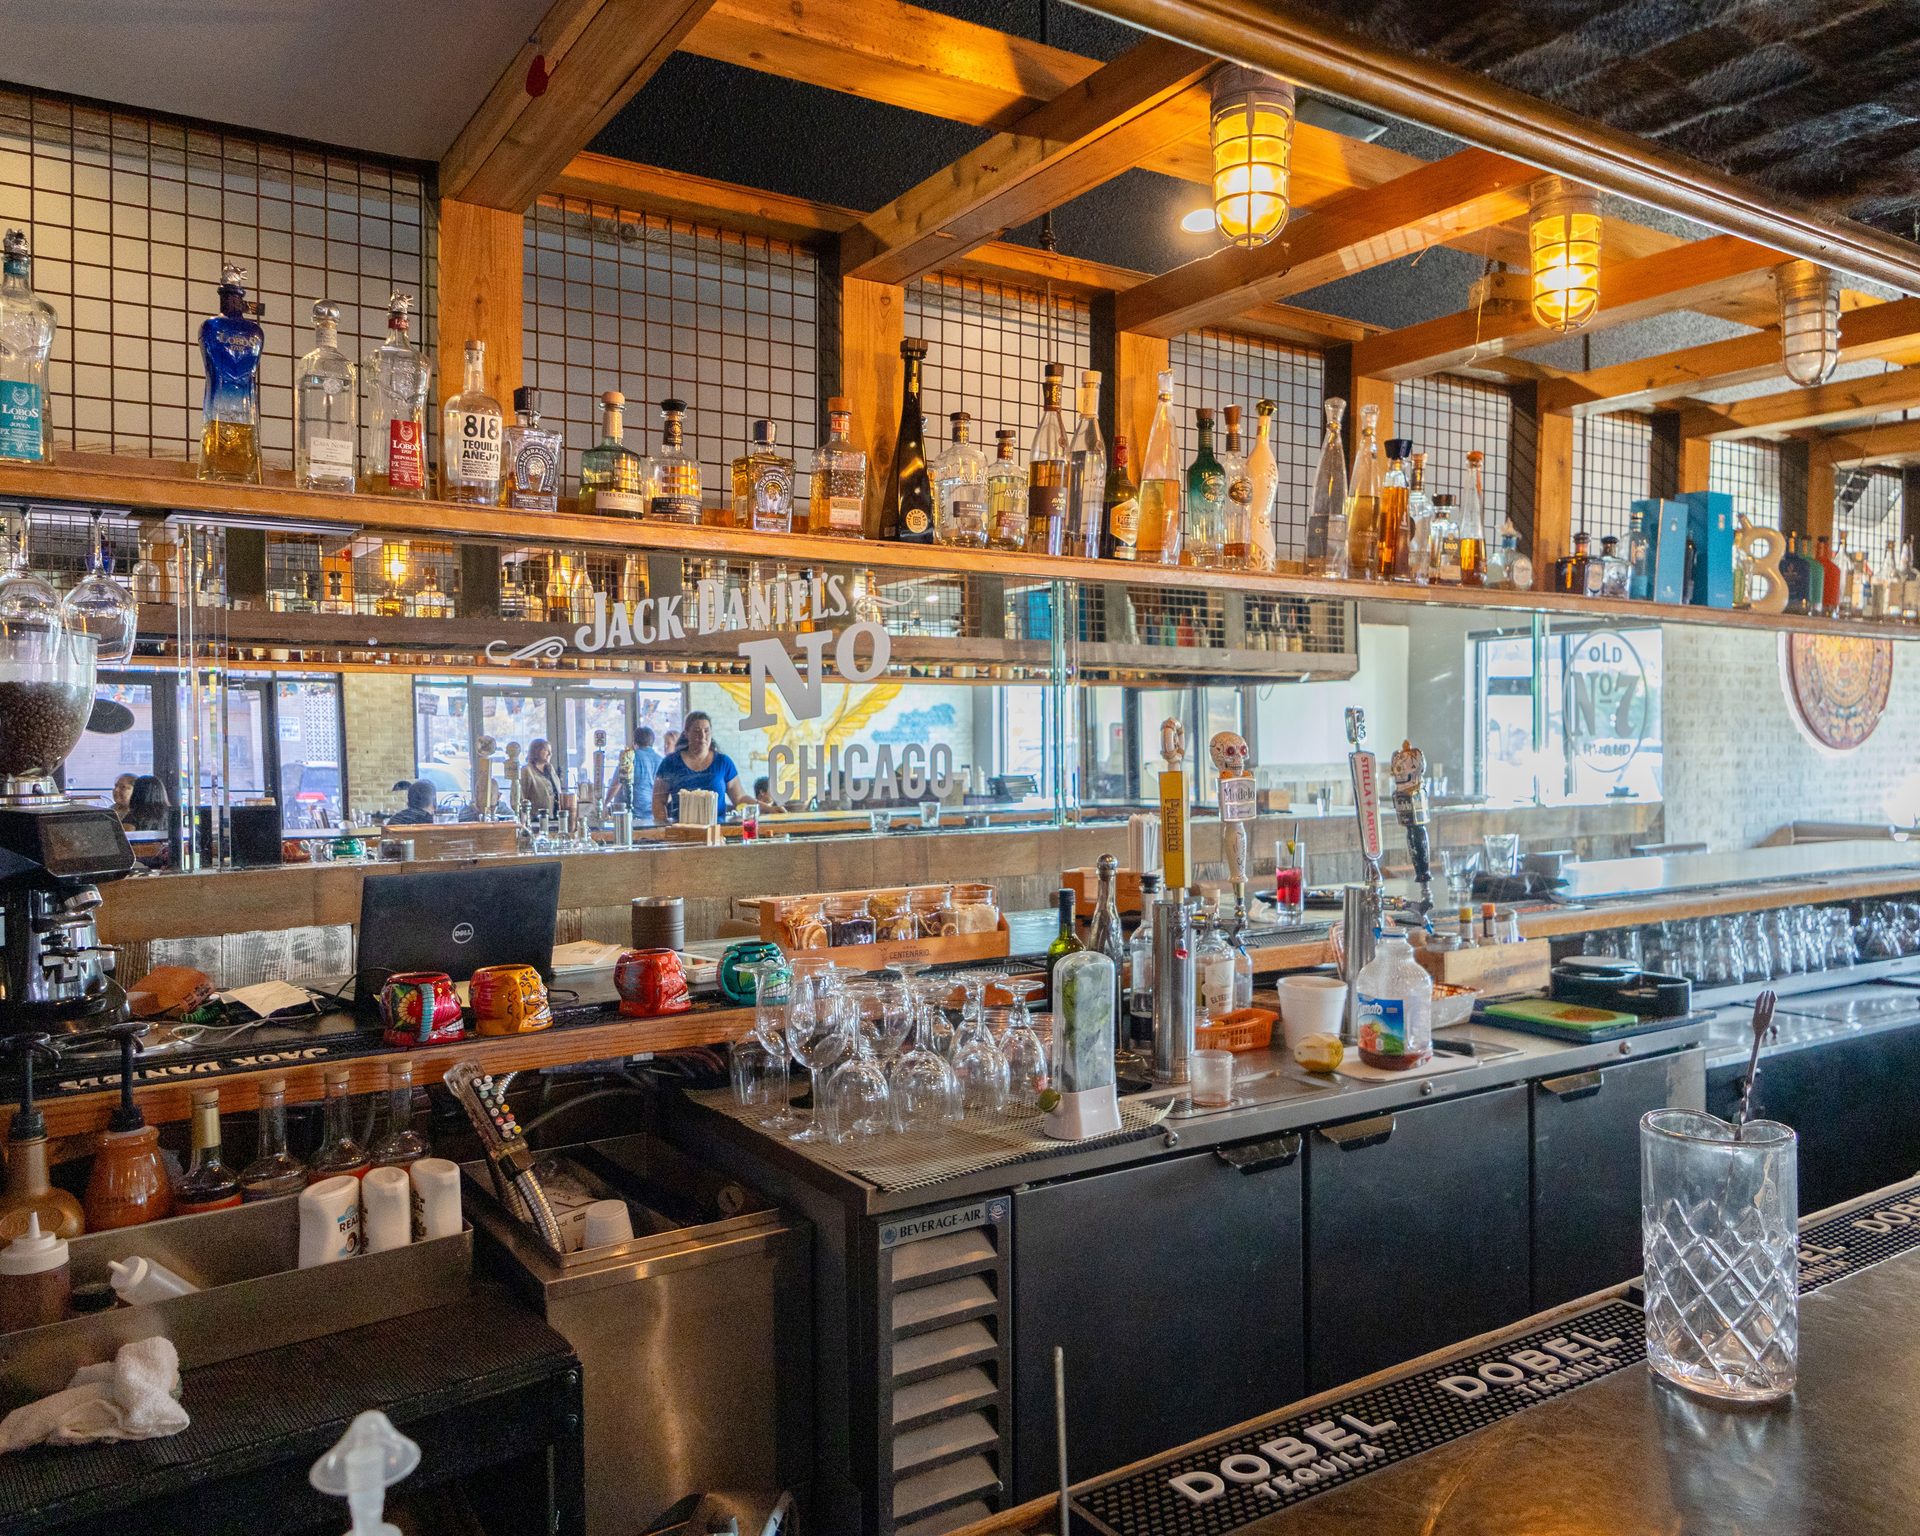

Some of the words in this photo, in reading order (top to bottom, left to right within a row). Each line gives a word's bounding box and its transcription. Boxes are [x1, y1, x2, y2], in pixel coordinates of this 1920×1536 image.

[2, 403, 39, 418] LOBOS
[463, 414, 499, 440] 818
[392, 439, 420, 451] LOBOS
[462, 439, 499, 453] TEQUILA
[574, 591, 686, 653] JACK
[1589, 642, 1623, 663] OLD
[767, 743, 954, 807] CHICAGO
[1360, 756, 1372, 797] STELLA
[1223, 785, 1256, 802] Modelo
[1365, 810, 1378, 853] ARTOIS
[455, 929, 471, 937] DELL
[889, 949, 930, 960] CENTENARIO
[232, 1047, 329, 1067] JACK
[900, 1208, 982, 1238] BEVERAGE-AIR
[1437, 1331, 1622, 1400] DOBEL
[1514, 1354, 1620, 1396] TEQUILA
[1168, 1413, 1398, 1504] DOBEL
[1253, 1443, 1386, 1500] TEQUILA
